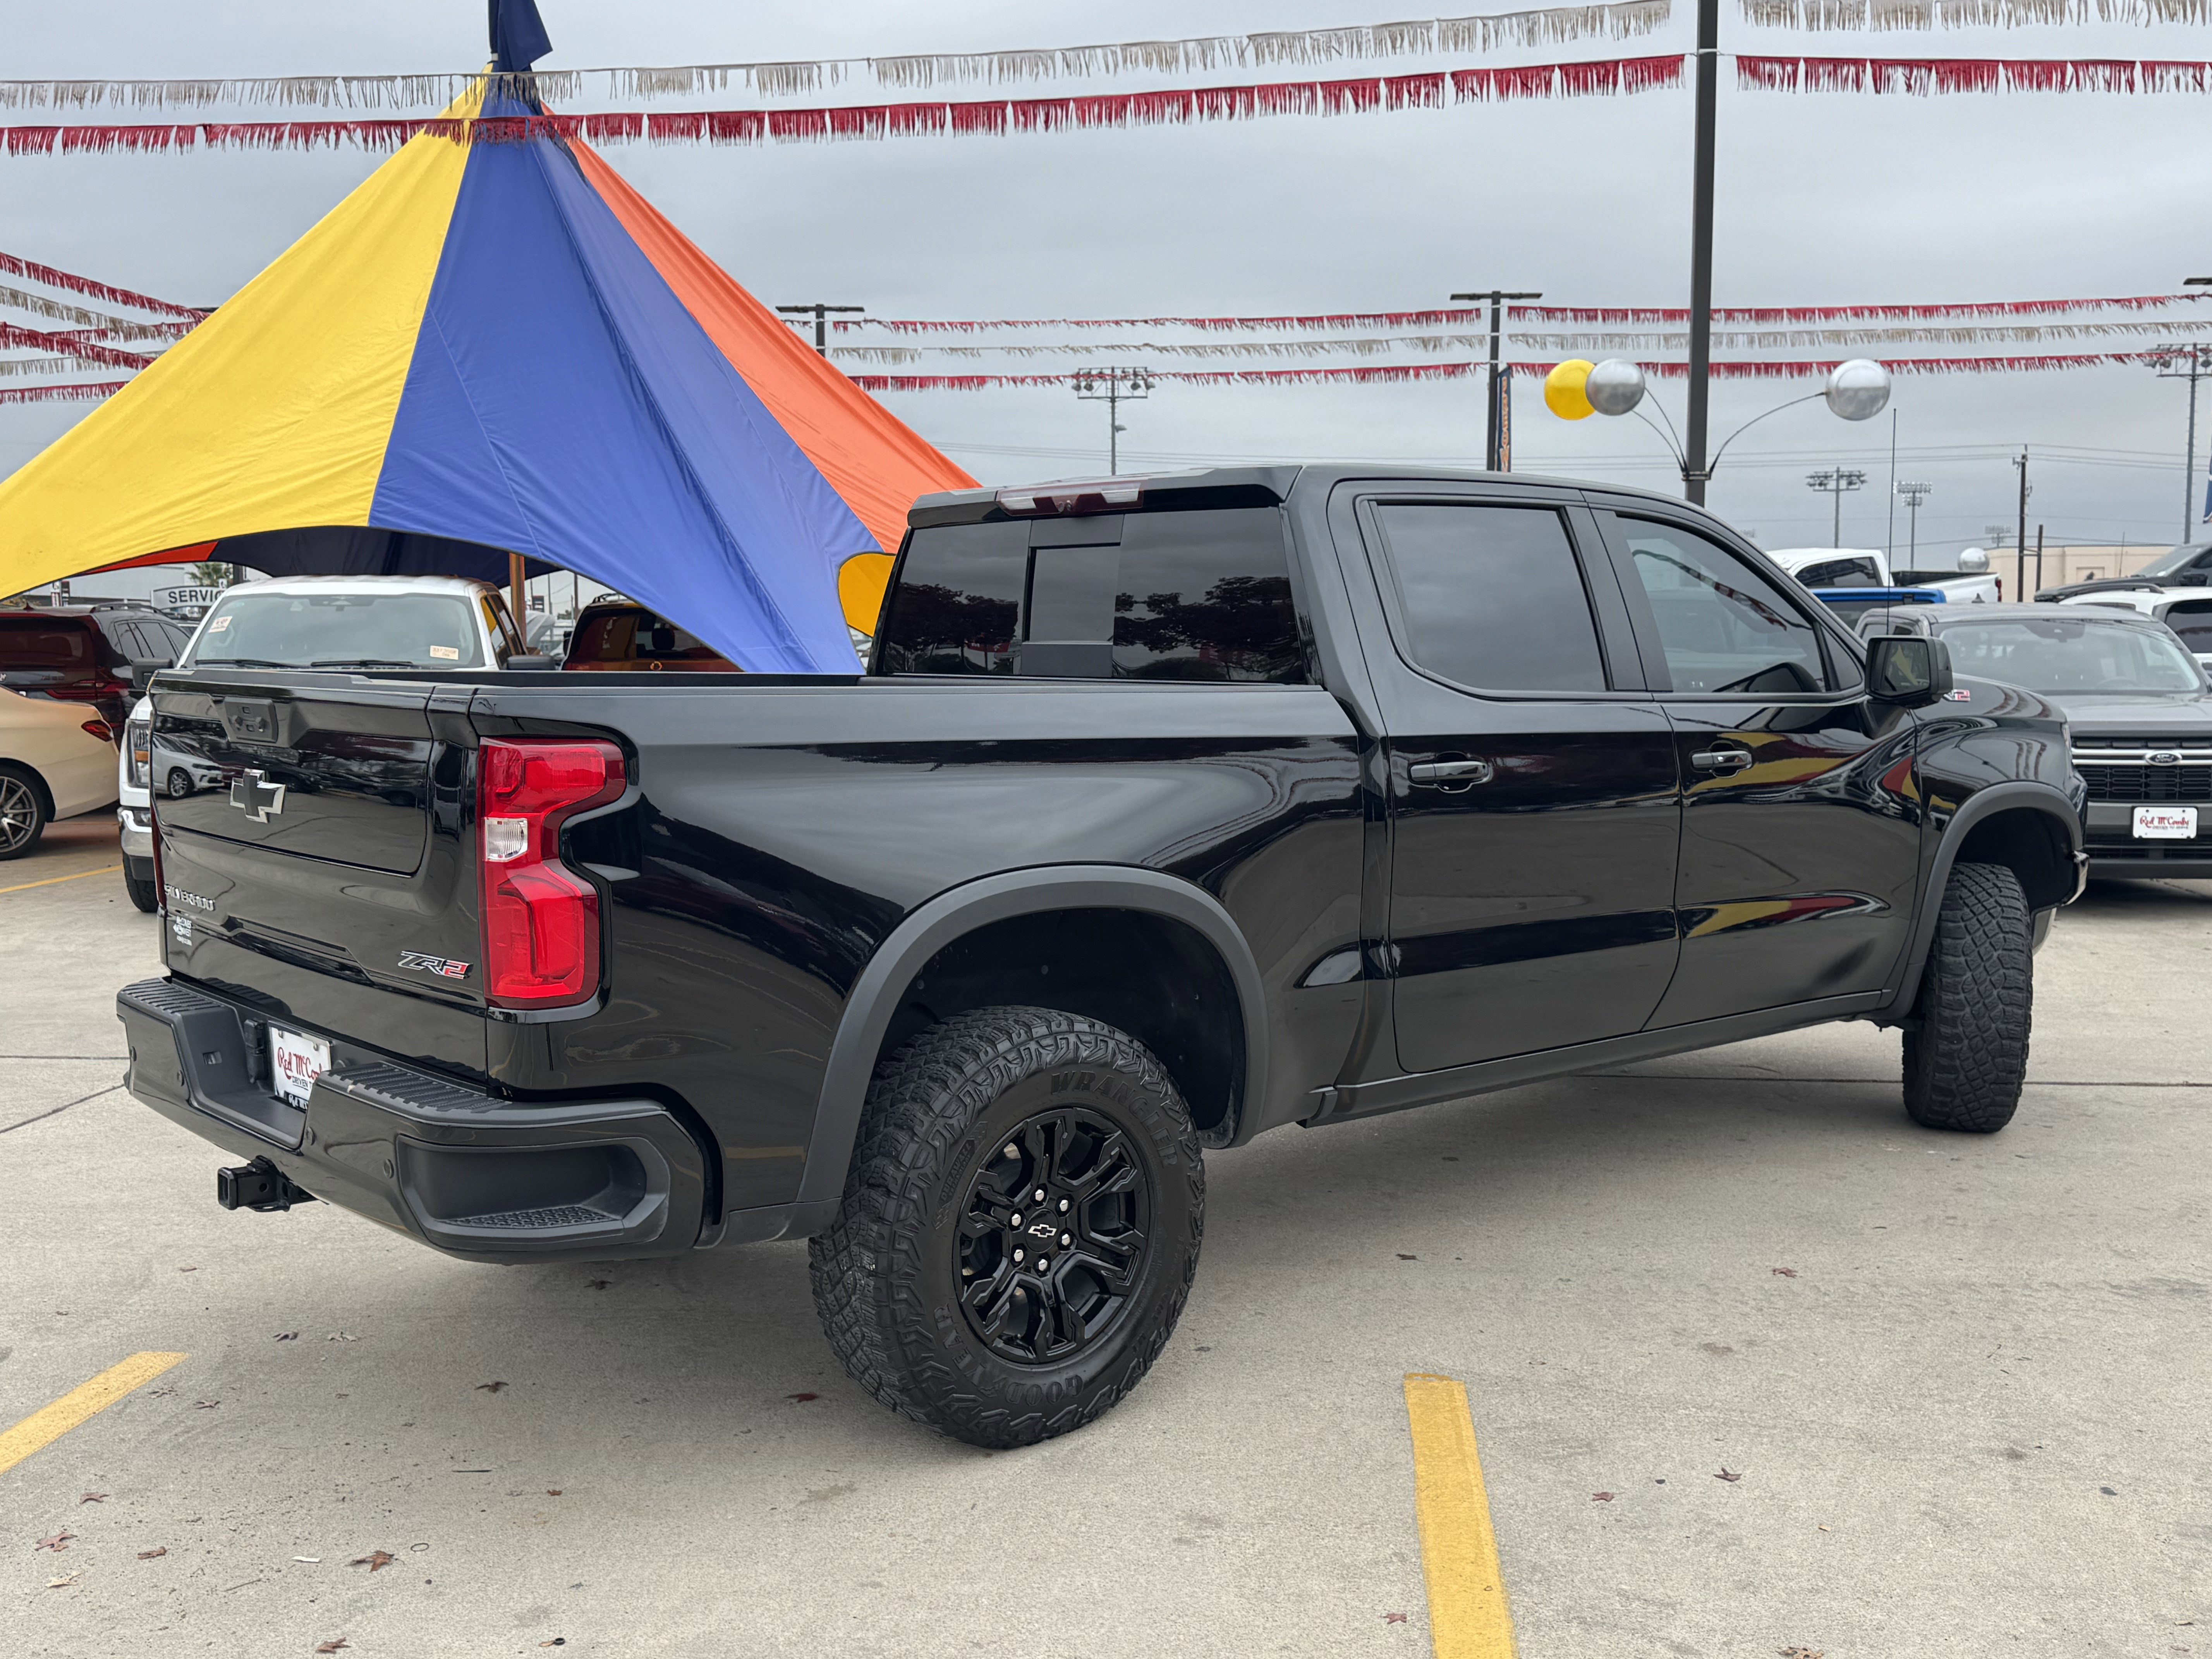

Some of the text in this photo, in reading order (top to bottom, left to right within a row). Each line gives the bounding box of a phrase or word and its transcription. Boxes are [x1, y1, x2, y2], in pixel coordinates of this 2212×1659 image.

[168, 590, 226, 604] SERVIC
[2140, 815, 2155, 828] Red
[398, 951, 470, 980] ZR2
[278, 1047, 293, 1080] Red
[292, 1076, 308, 1087] DRIVEN
[1051, 1070, 1178, 1167] WRANGLER
[934, 1303, 1084, 1406] GOODYEAR
